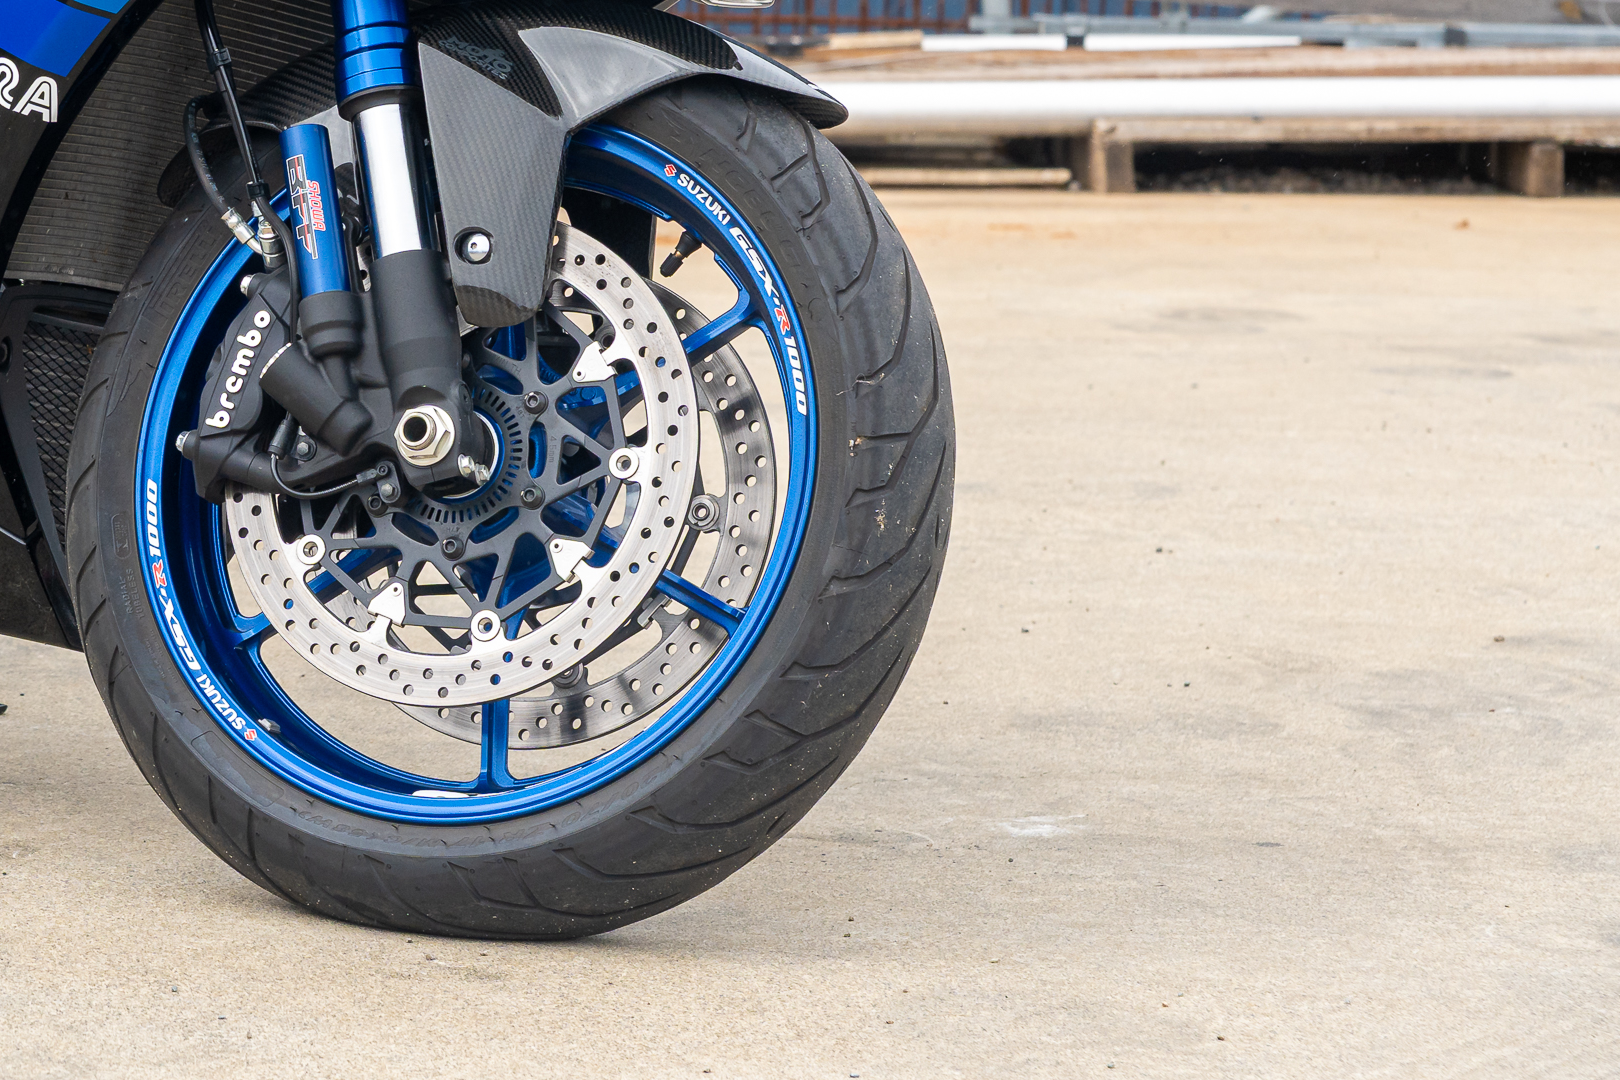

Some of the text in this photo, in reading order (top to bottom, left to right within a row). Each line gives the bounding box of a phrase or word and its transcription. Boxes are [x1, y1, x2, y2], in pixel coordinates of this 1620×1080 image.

[307, 180, 327, 231] SHOWA
[677, 173, 731, 226] SUZUKI
[205, 309, 271, 429] brembo
[195, 673, 246, 731] SUZUKI
